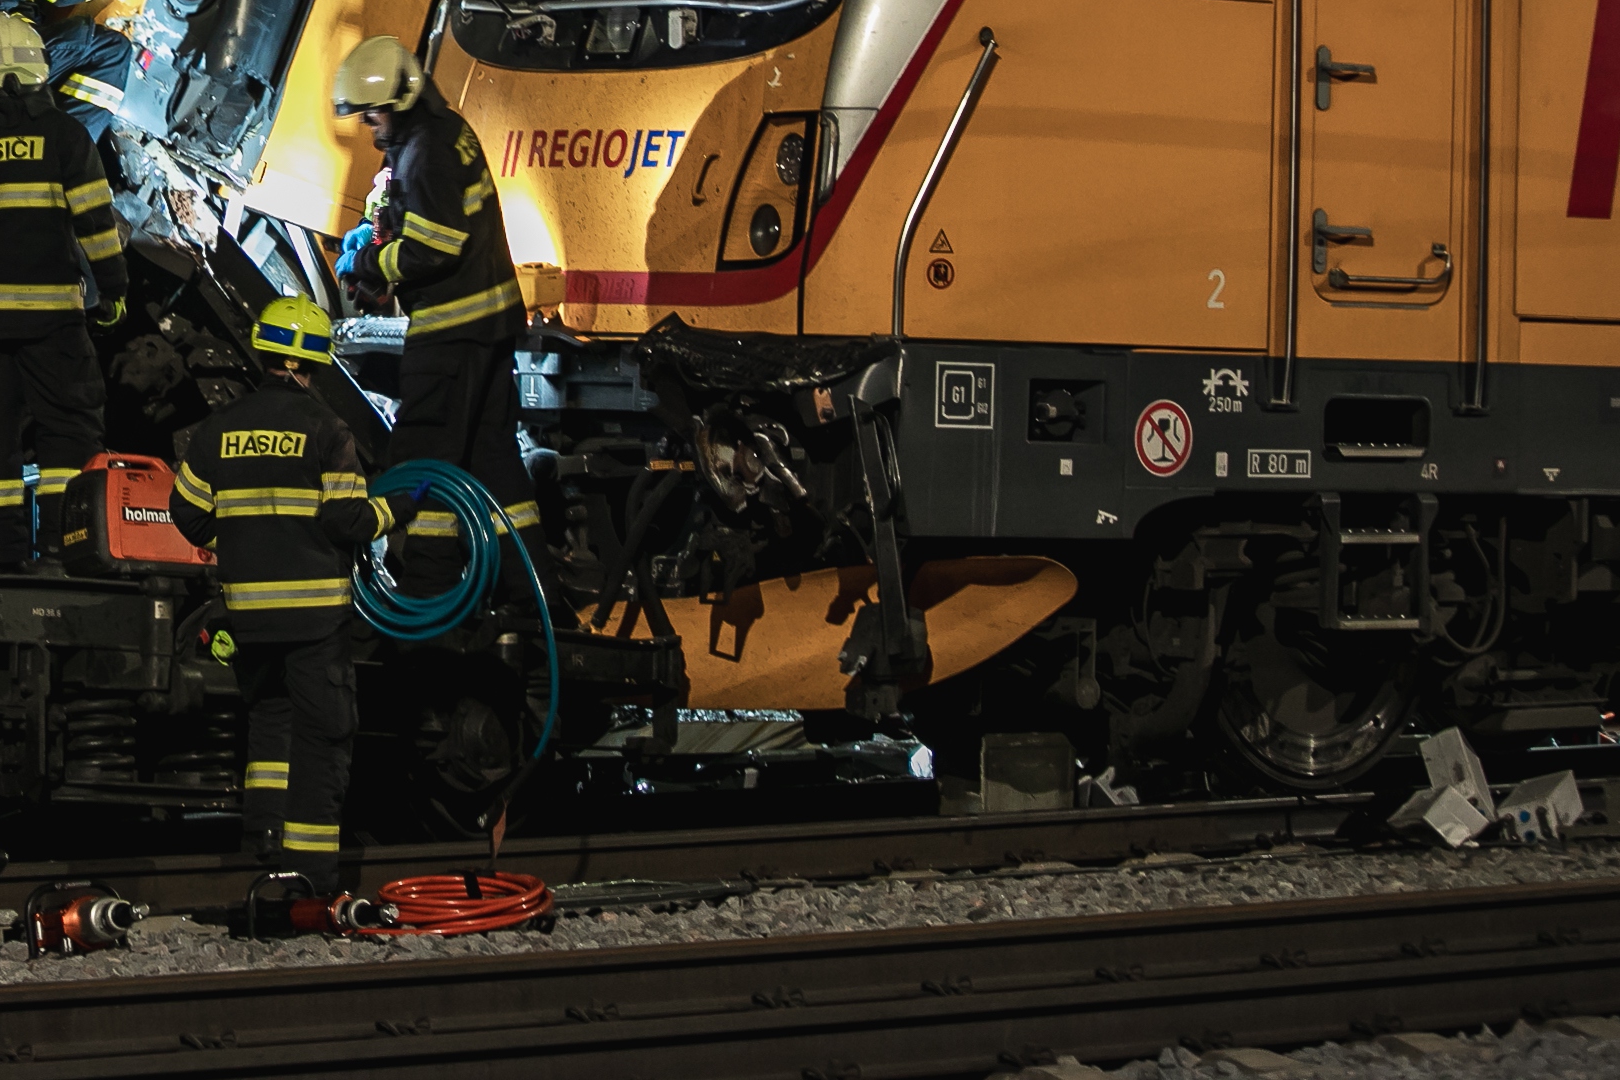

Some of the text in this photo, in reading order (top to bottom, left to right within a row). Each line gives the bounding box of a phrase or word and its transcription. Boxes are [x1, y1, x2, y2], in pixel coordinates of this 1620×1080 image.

[527, 128, 686, 179] REGIOJET
[1206, 268, 1226, 309] 2
[225, 432, 301, 456] HASIČI
[1251, 453, 1307, 474] R 80 m
[1420, 462, 1439, 480] 4R
